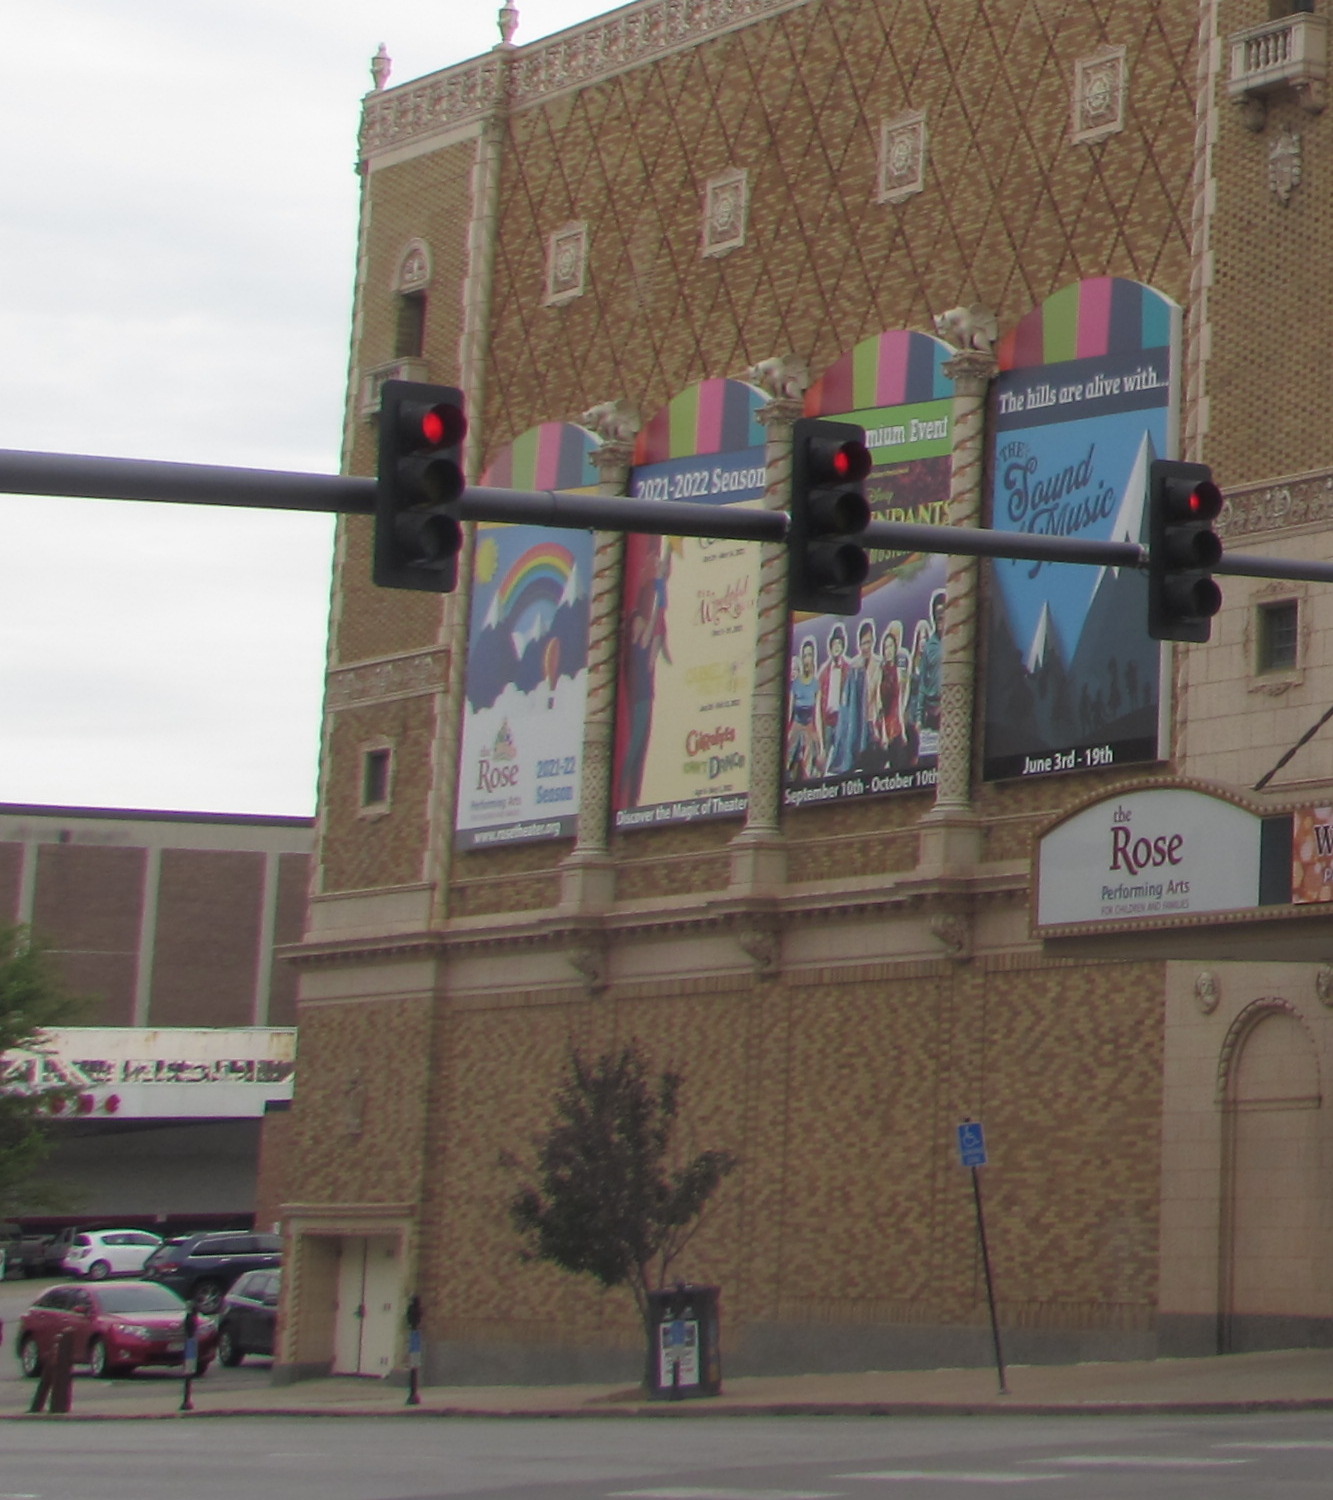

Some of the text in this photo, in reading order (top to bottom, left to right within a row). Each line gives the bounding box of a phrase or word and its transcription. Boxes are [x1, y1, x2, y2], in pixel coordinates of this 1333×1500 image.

[1000, 365, 1169, 414] The hills are alive with...
[910, 416, 949, 443] Event
[1000, 442, 1024, 462] THE
[635, 467, 766, 500] 2021-2022 Season
[1004, 443, 1095, 523] Sound
[1028, 480, 1115, 555] Music
[476, 759, 519, 793] Rose
[1022, 757, 1052, 774] June
[1054, 750, 1075, 770] 3rd
[1086, 745, 1113, 765] 19th
[784, 783, 839, 806] September
[841, 778, 864, 796] 10th
[871, 773, 914, 792] October
[915, 768, 939, 786] 10th
[616, 796, 748, 826] Discover the Magic of Theater
[1114, 806, 1131, 823] the
[1109, 826, 1183, 875] Rose
[1102, 880, 1190, 900] Performing Arts
